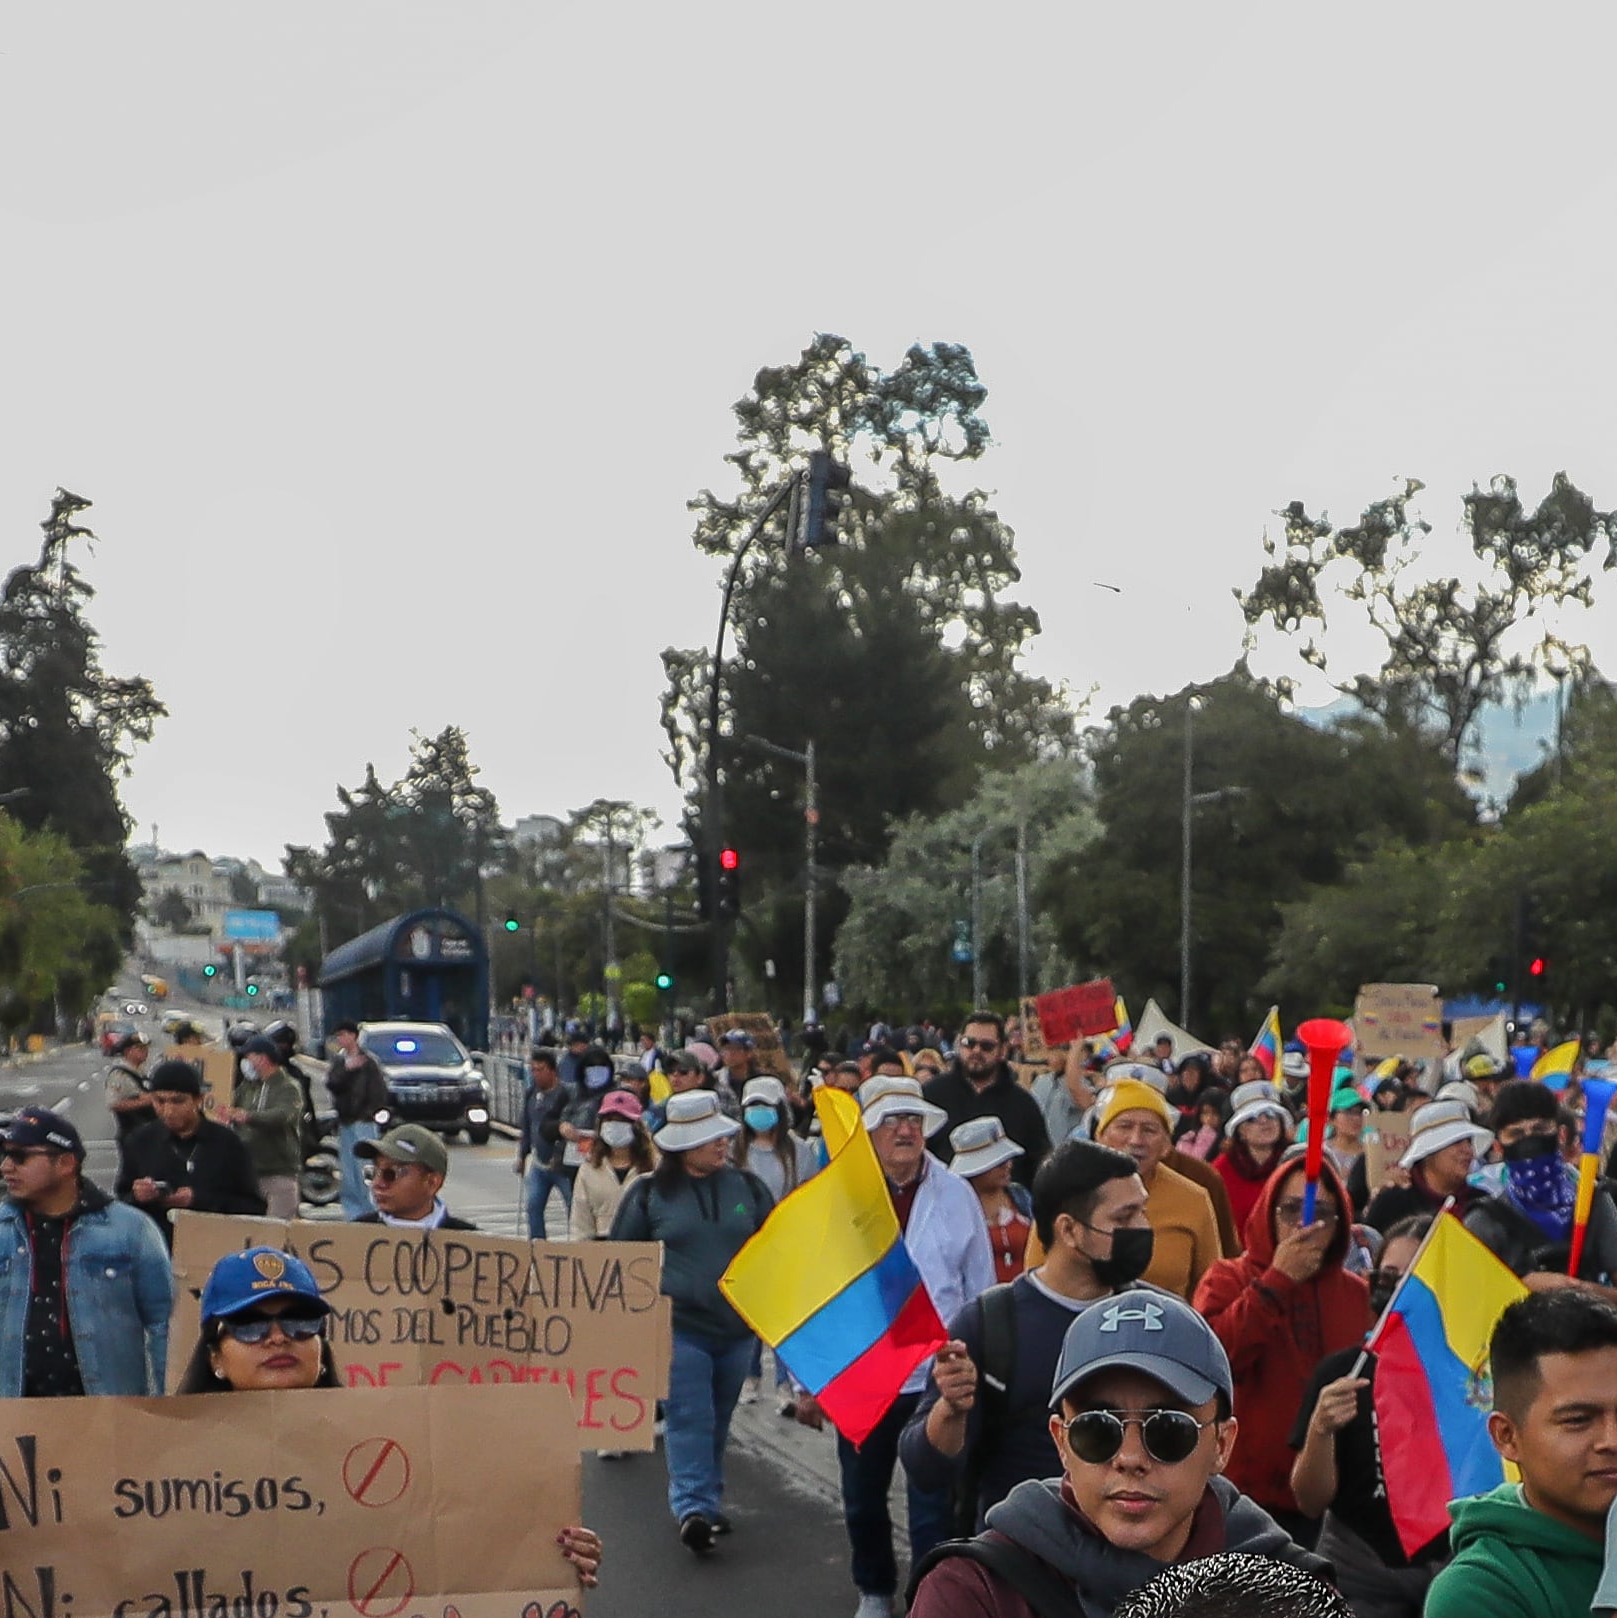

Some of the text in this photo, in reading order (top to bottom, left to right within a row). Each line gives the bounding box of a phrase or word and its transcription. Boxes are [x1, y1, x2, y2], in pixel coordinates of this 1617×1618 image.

[391, 1307, 445, 1344] DEL
[456, 1306, 572, 1355] PUEBLO
[113, 1468, 326, 1519] sumisos,
